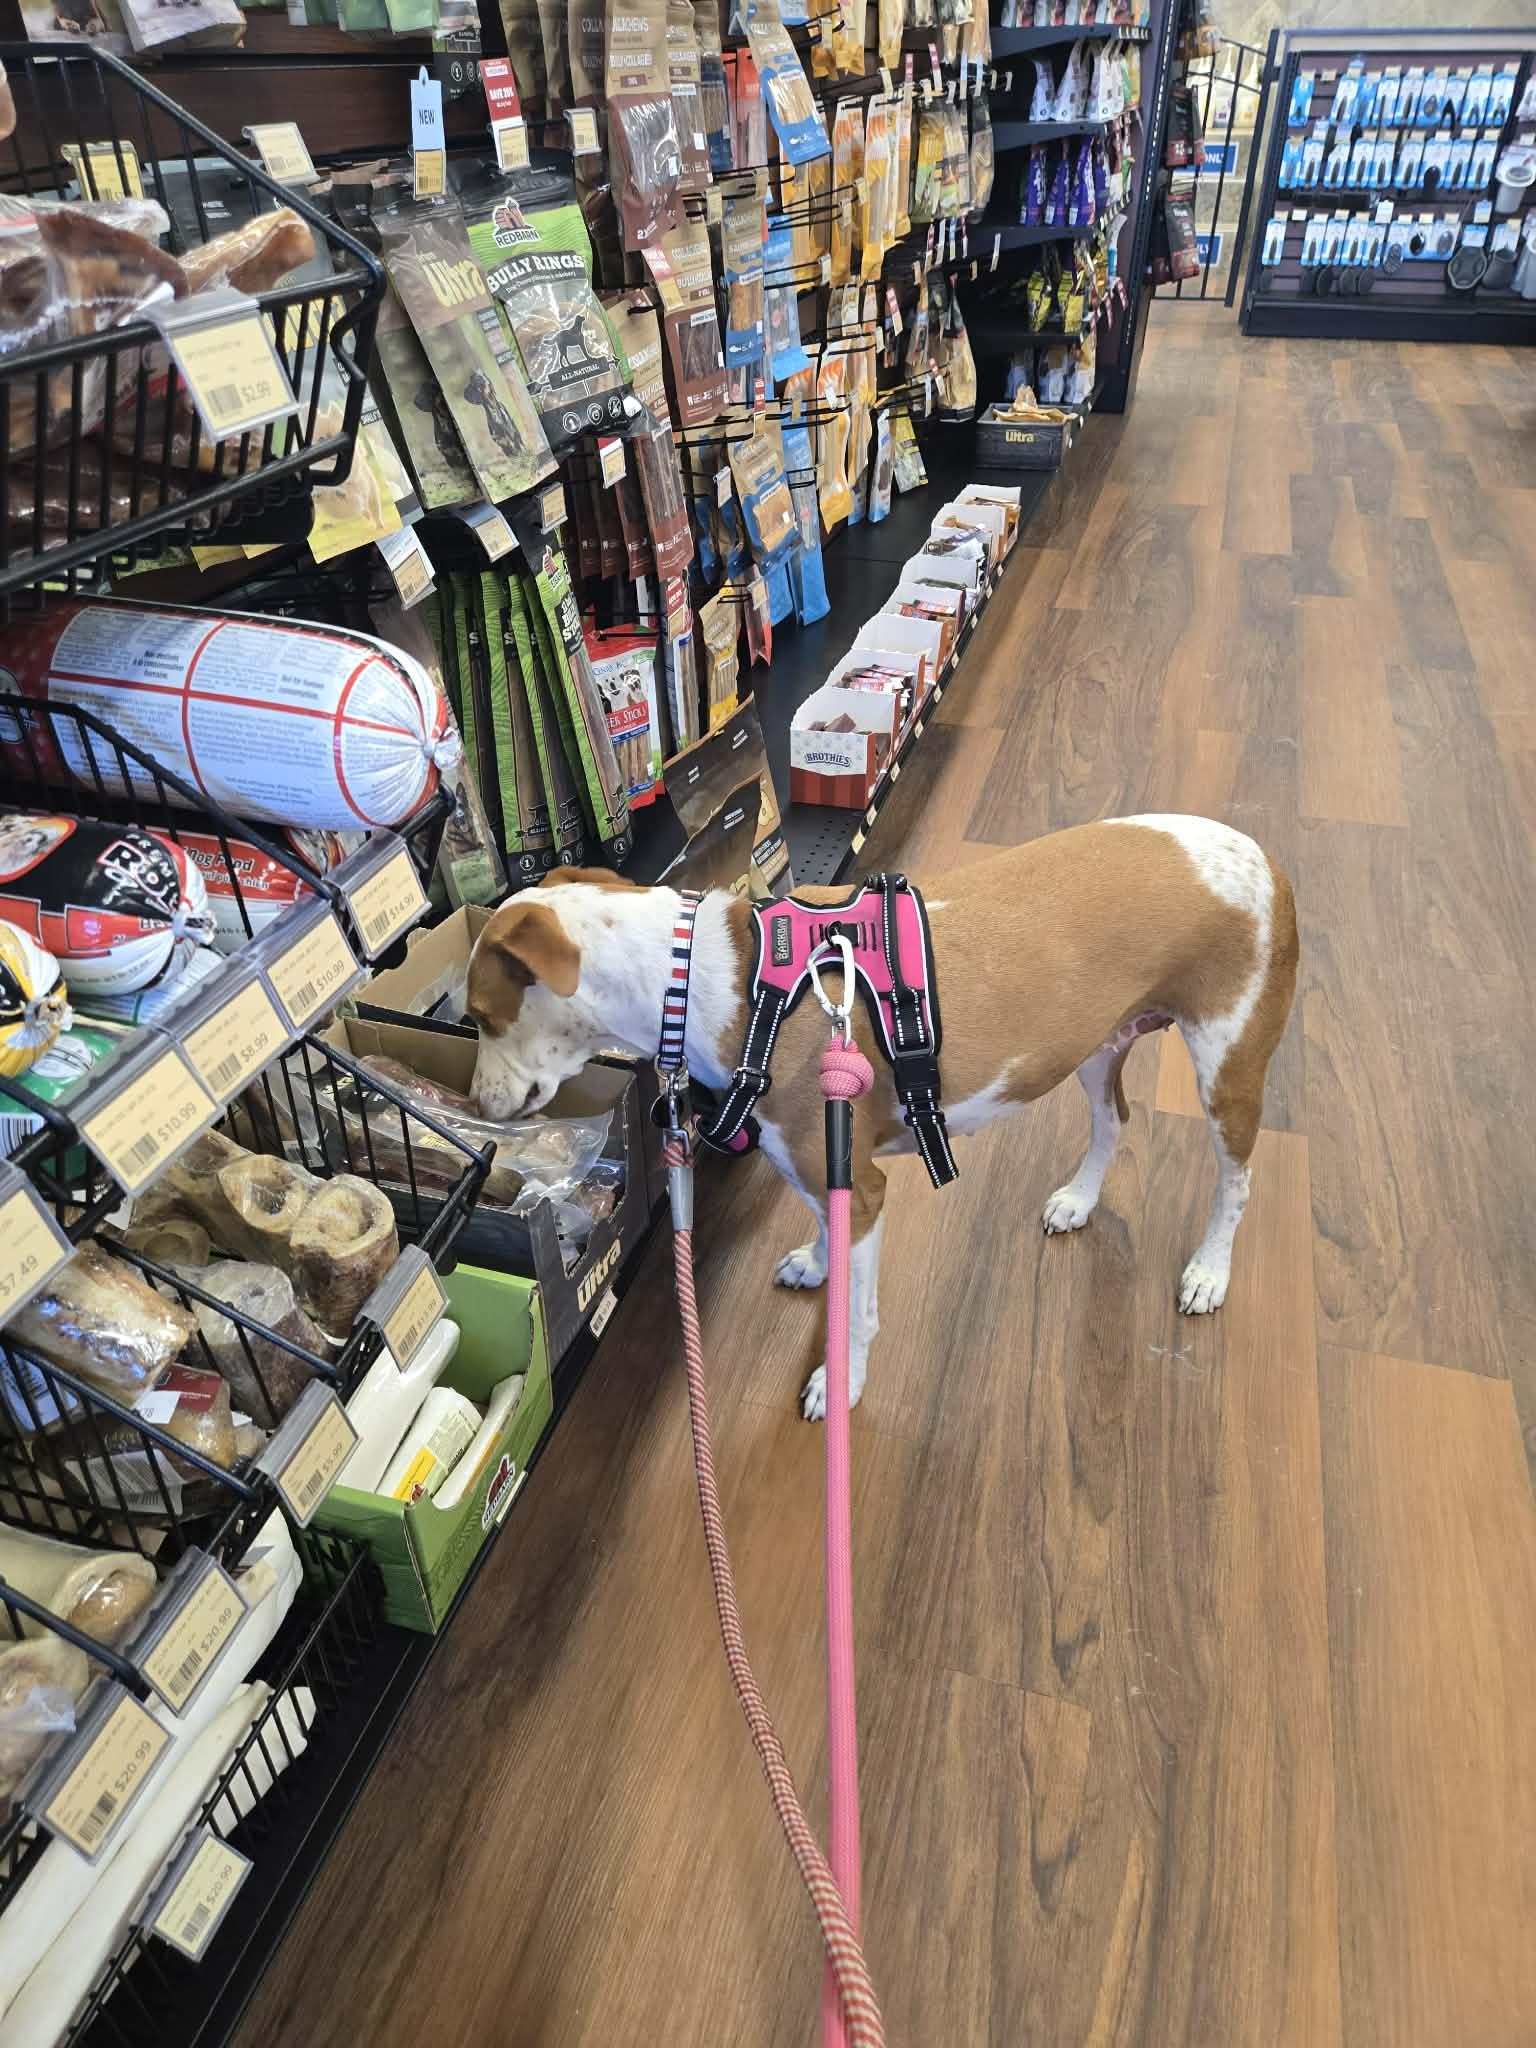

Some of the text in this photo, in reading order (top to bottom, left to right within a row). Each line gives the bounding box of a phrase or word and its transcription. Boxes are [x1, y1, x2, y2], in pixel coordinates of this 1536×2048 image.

[418, 109, 435, 126] NEW
[495, 229, 539, 247] REDBARN
[422, 259, 486, 308] Ultra
[486, 257, 533, 294] BULLY
[532, 254, 585, 271] RINGS
[561, 363, 600, 382] ALL-NATURAL
[1006, 430, 1034, 443] Ultra
[805, 752, 850, 766] BROTHIES
[389, 893, 415, 920] $14.99
[775, 917, 789, 961] BARKBAY
[316, 960, 345, 992] $10.99
[239, 1032, 269, 1064] $8.99
[157, 1101, 197, 1142] $10.99
[0, 1255, 38, 1297] $7.49
[577, 1238, 621, 1312] Ultra
[200, 1606, 233, 1655] $20.99
[114, 1740, 153, 1794] $20.99
[205, 1863, 234, 1906] $20.99
